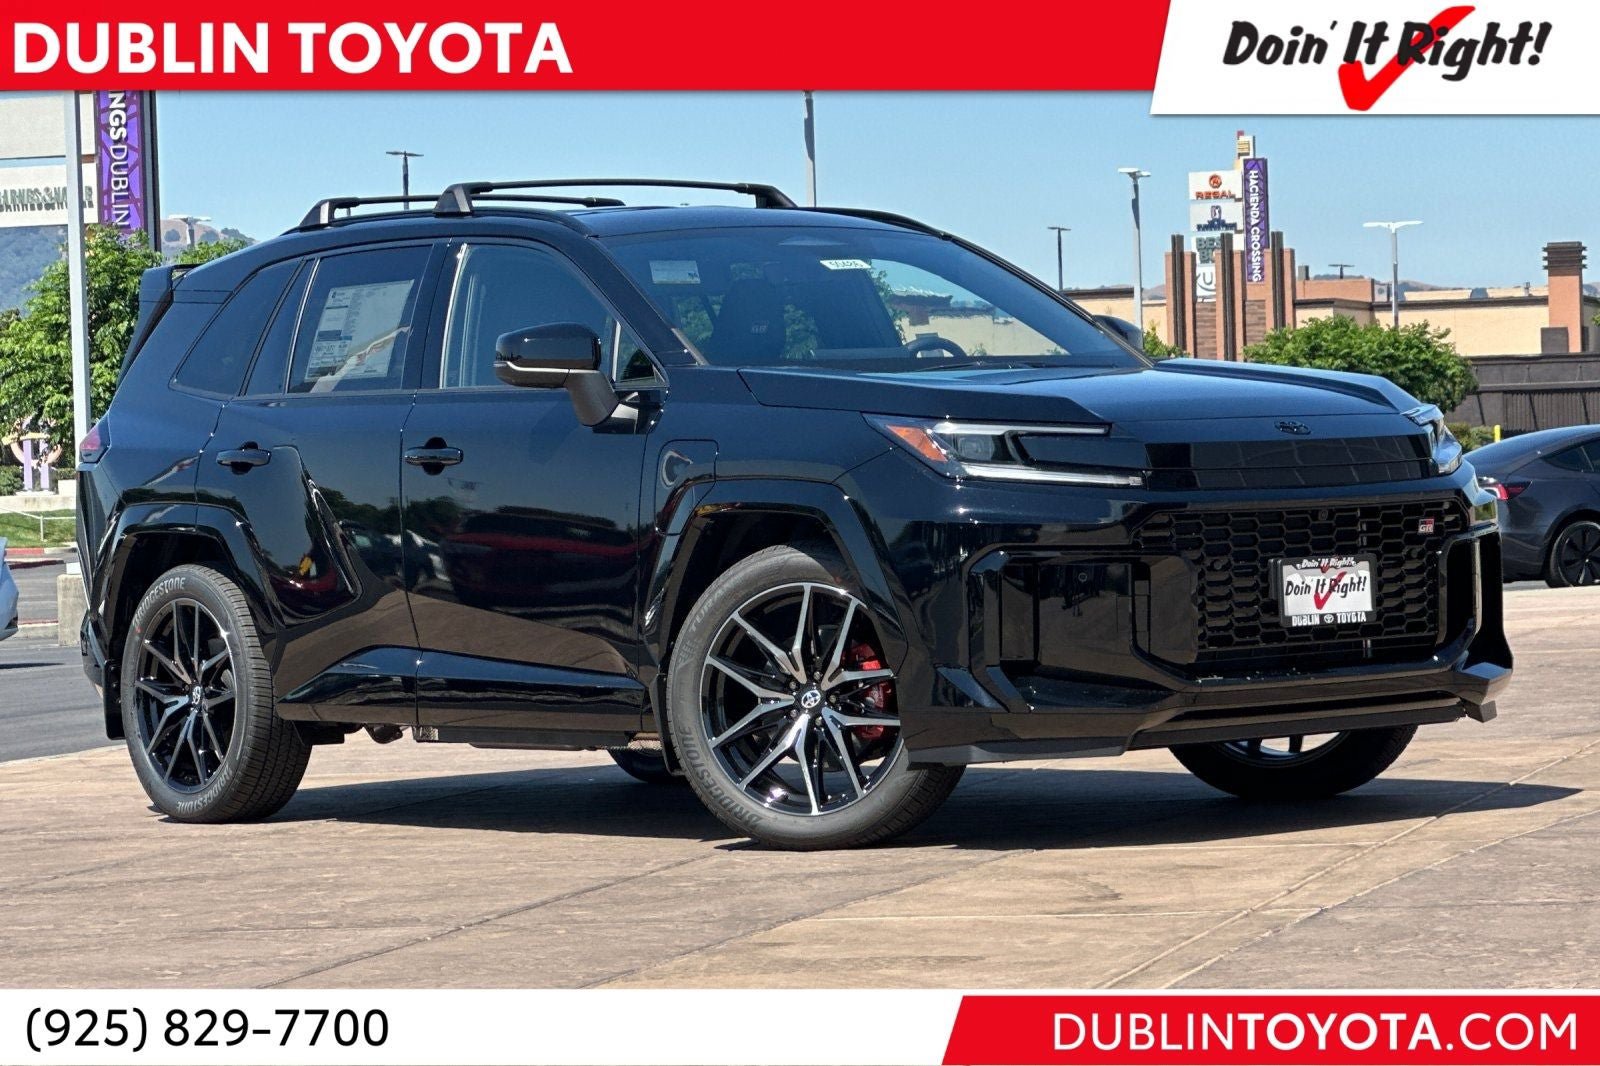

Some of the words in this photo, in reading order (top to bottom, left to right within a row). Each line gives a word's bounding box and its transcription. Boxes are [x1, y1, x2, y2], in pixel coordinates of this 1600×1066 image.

[110, 145, 130, 226] DUBLIN
[1195, 190, 1236, 200] REGAL
[1249, 170, 1260, 225] HACIENDA
[1196, 236, 1222, 250] BES
[1419, 524, 1434, 533] GR
[1315, 578, 1326, 594] It
[1329, 576, 1367, 599] Right!
[1292, 614, 1320, 626] DUBLIN
[1337, 611, 1367, 624] TOYOTA
